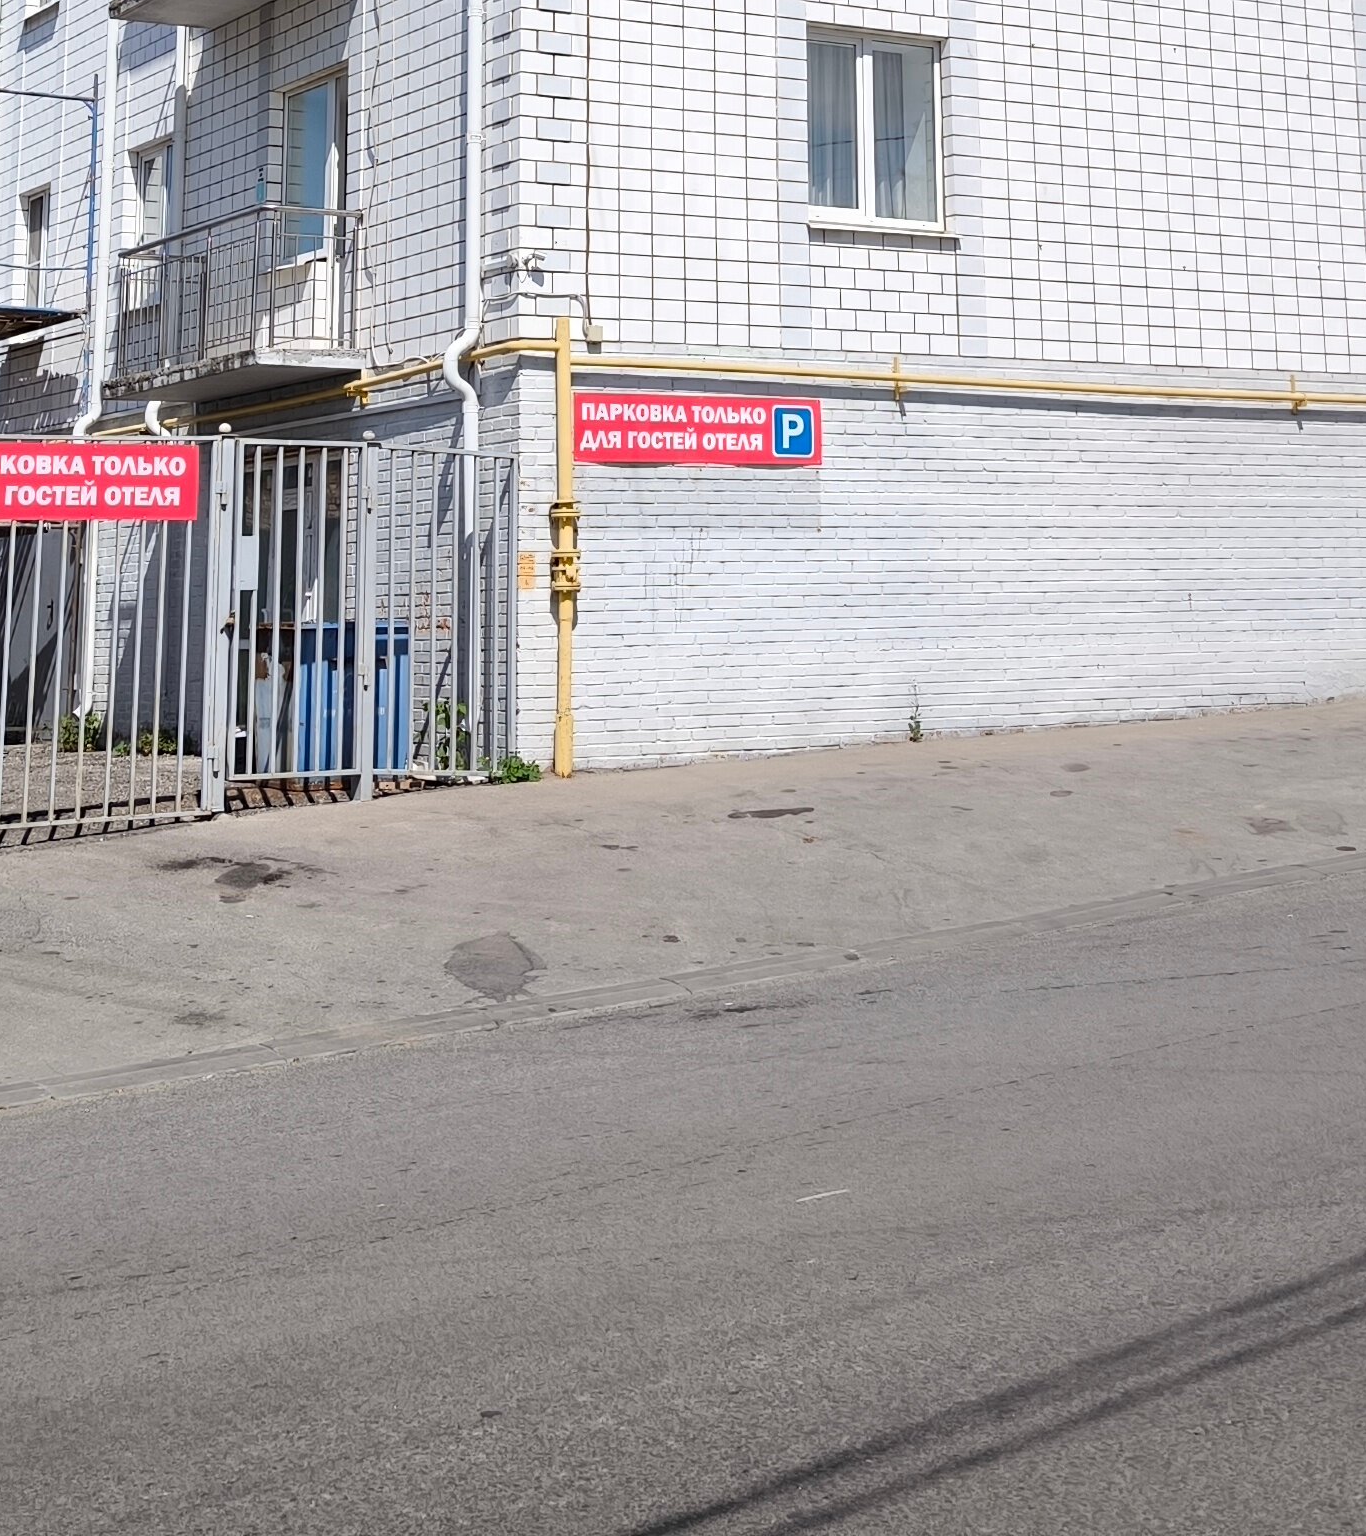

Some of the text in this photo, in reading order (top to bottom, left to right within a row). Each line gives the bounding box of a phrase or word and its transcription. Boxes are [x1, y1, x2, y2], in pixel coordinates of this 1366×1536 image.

[581, 403, 766, 425] ПАРКОВКА ТОЛЬКО
[580, 427, 763, 451] ДЛЯ ГОСТЕЙ ОТЕЛЯ
[782, 414, 805, 449] P
[91, 455, 187, 477] ТОЛЬКО
[4, 480, 97, 507] ГОСТЕЙ
[104, 486, 181, 507] ОТЕЛЯ
